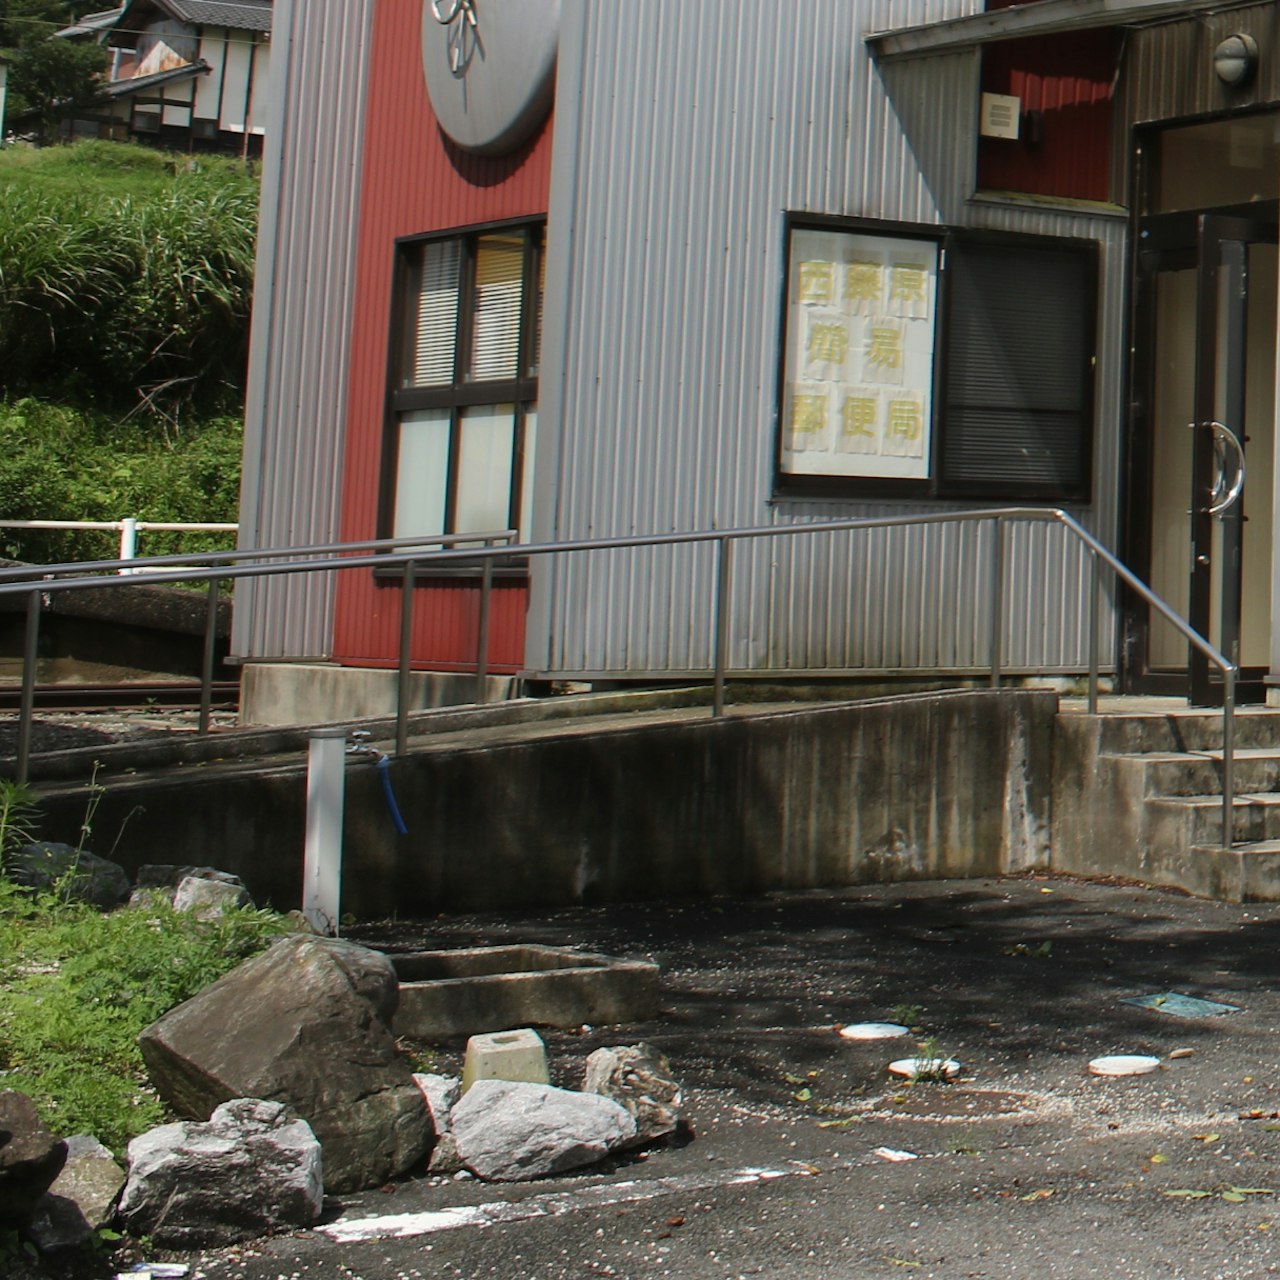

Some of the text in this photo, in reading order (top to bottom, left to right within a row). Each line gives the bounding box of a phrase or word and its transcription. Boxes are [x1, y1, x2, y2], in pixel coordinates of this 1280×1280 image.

[799, 261, 926, 301] 西藤原
[808, 323, 902, 368] 簡易
[793, 395, 920, 440] 郵便局
